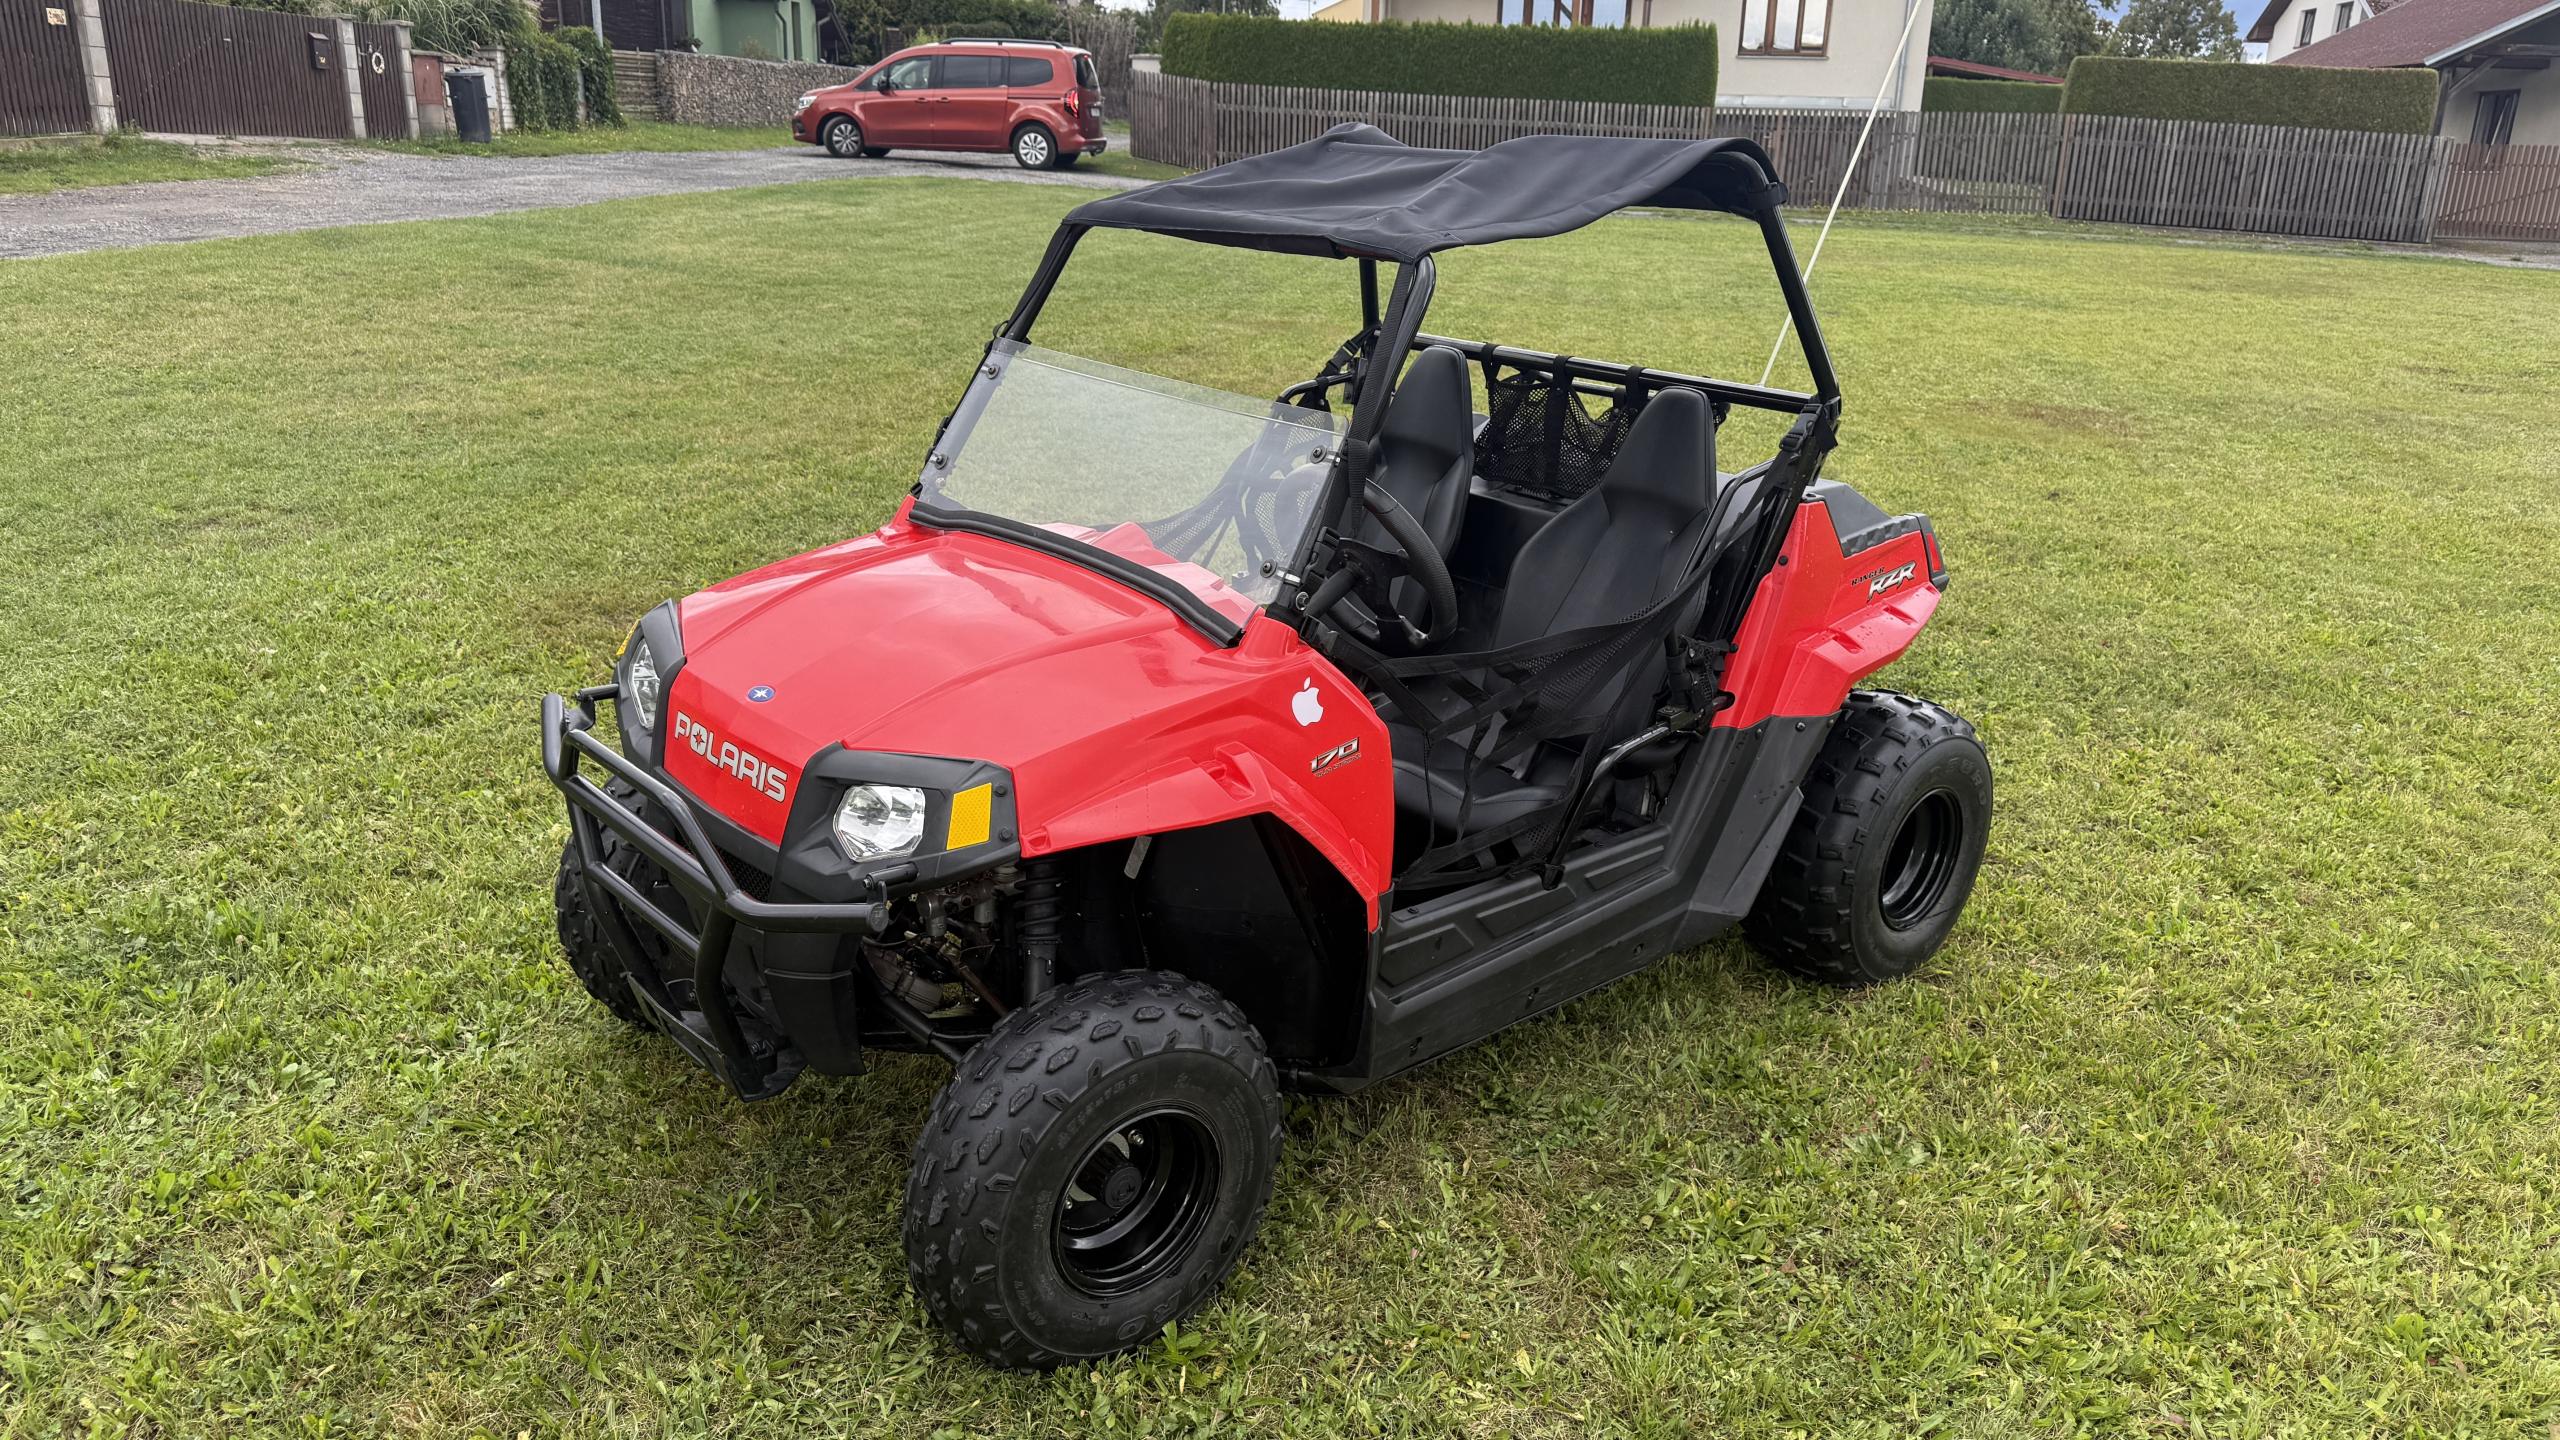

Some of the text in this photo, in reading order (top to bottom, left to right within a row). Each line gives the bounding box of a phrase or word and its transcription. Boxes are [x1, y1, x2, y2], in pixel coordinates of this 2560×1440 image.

[1867, 560, 1917, 604] RZR
[674, 710, 789, 803] POLARIS
[1311, 737, 1360, 773] 170
